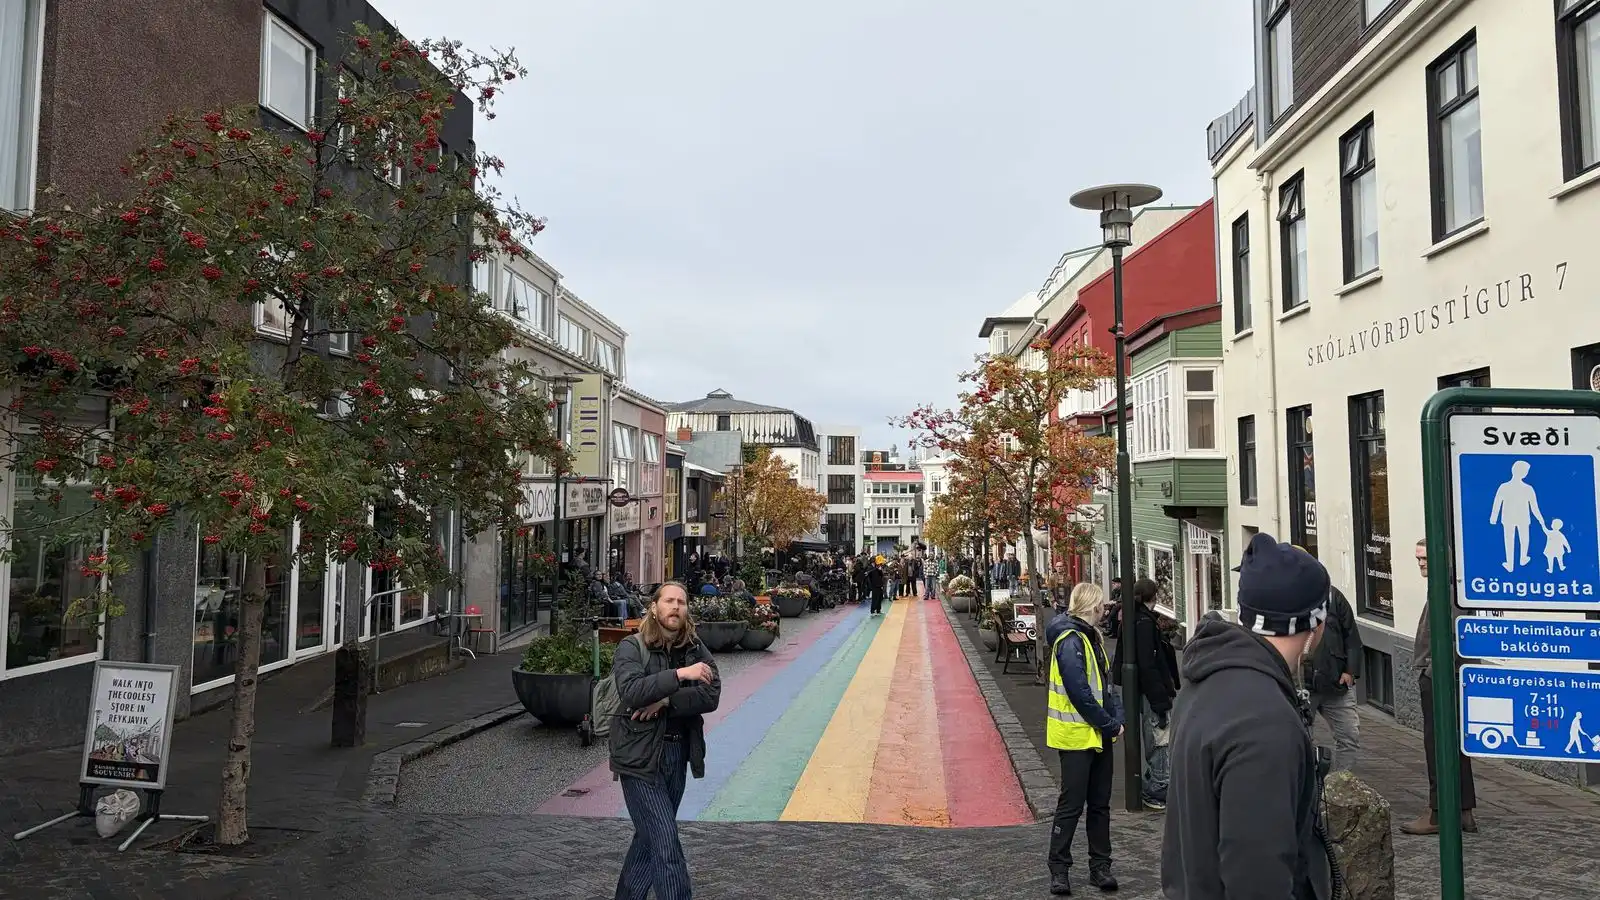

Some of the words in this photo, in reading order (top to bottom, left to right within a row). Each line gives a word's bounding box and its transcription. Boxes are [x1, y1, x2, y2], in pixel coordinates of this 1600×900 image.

[1307, 273, 1535, 367] SKÓLAVÖRÐUSTÍGUR
[1555, 262, 1568, 291] 7
[1483, 426, 1569, 446] Svæði
[1306, 503, 1316, 526] 66
[1471, 577, 1593, 598] Göngugata
[1463, 622, 1509, 634] Akstur
[1513, 624, 1585, 637] heimilaður
[1590, 628, 1600, 638] a
[1500, 640, 1571, 654] baklóðum
[112, 678, 132, 688] WALK
[135, 680, 153, 691] INTO
[1468, 673, 1566, 688] Vöruafgreiðsla
[1530, 692, 1558, 705] 7-11
[111, 702, 134, 713] STORE
[137, 704, 145, 712] IN
[1524, 704, 1565, 719] (8-11)
[108, 714, 148, 725] REYKJAVIK
[93, 769, 136, 778] SOUVENIRS
